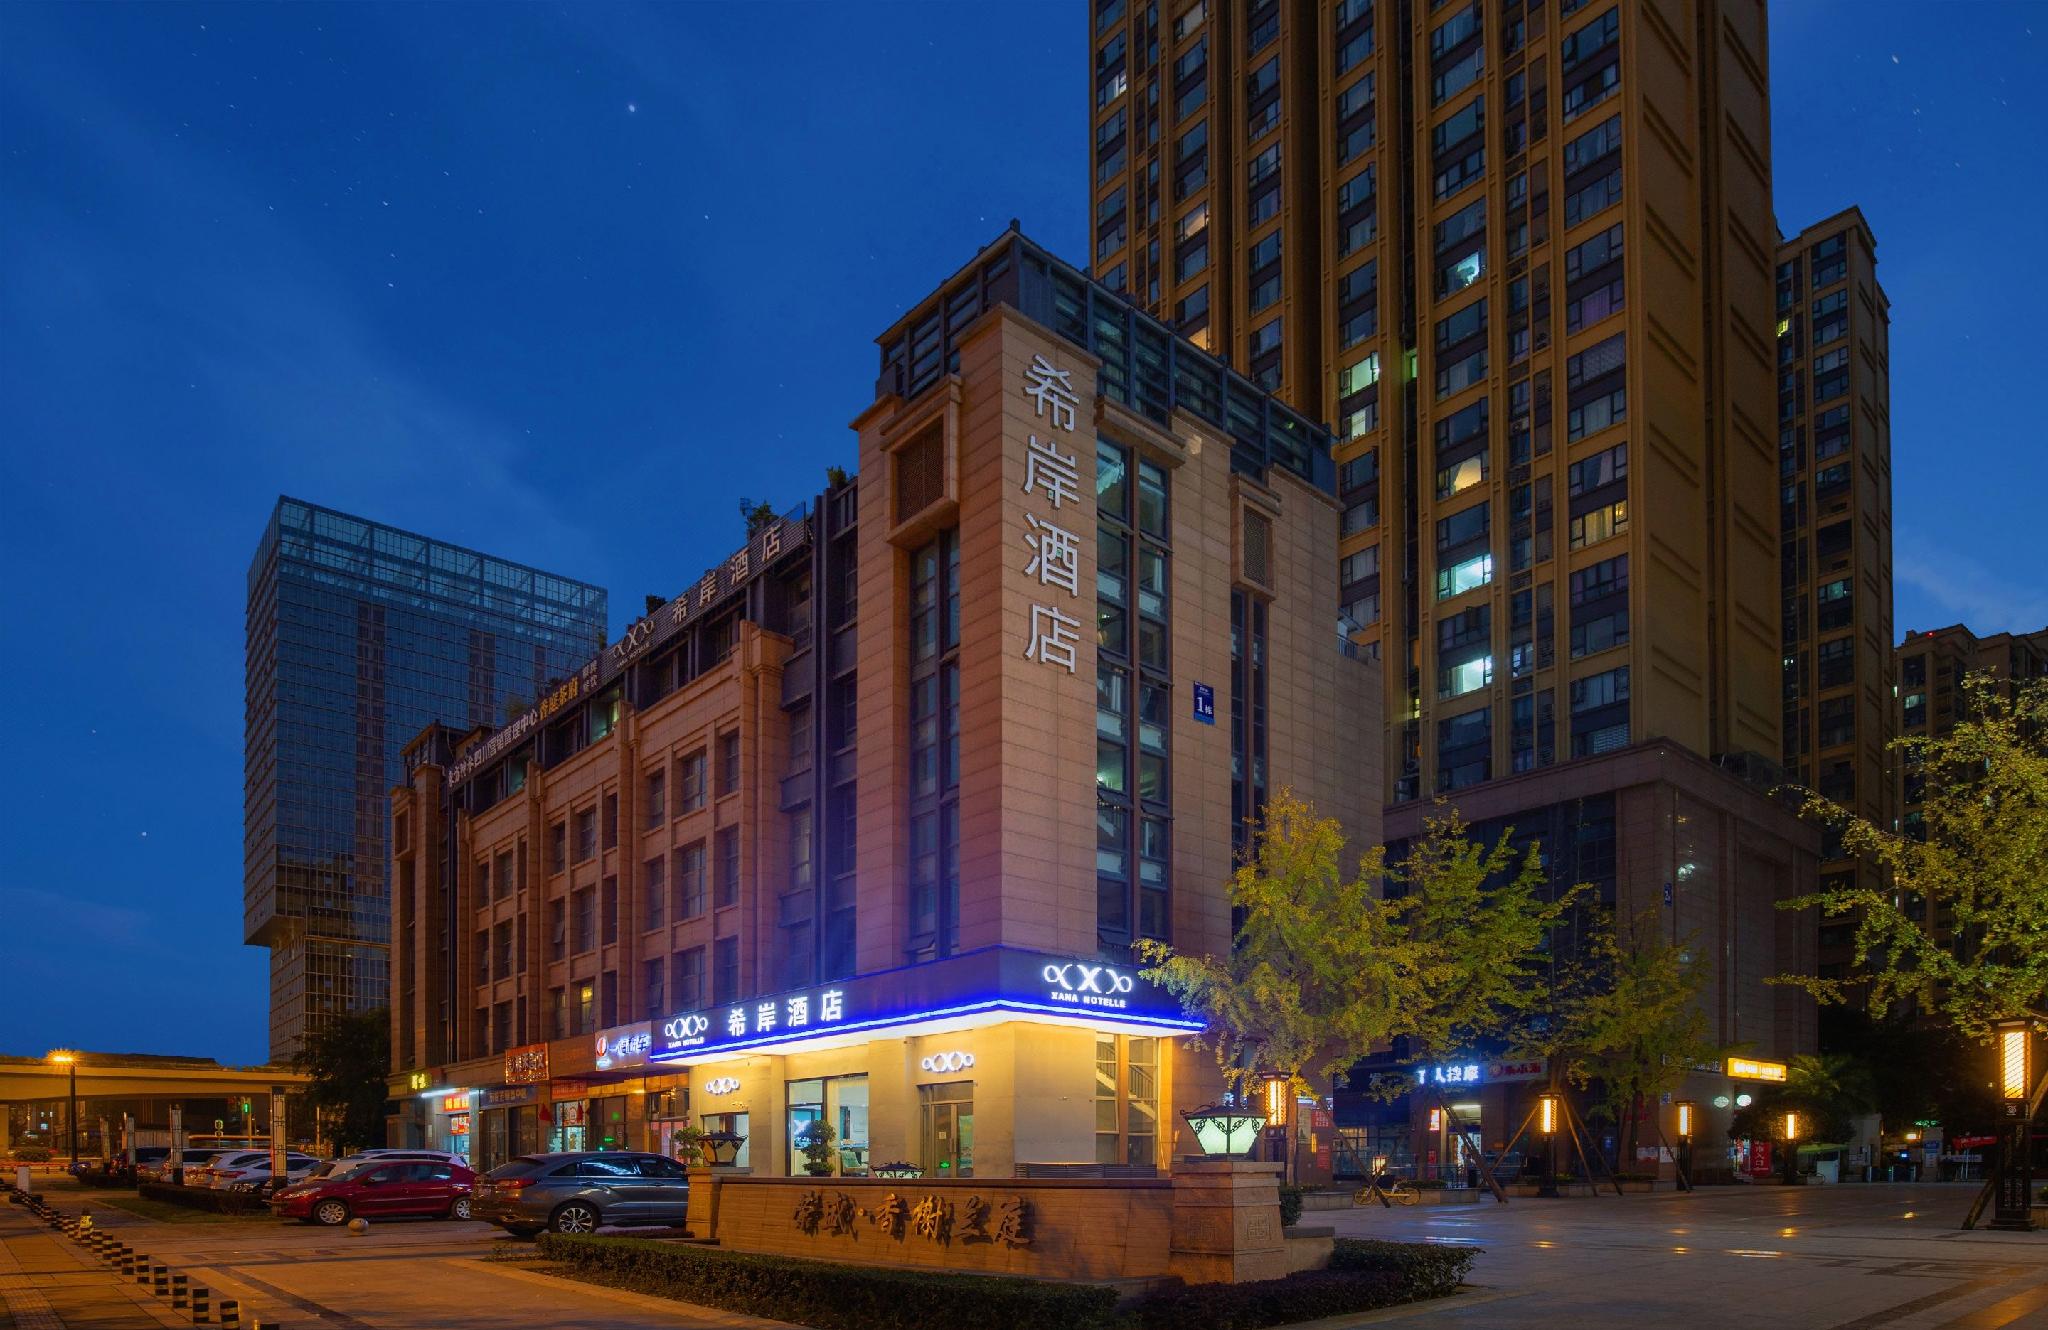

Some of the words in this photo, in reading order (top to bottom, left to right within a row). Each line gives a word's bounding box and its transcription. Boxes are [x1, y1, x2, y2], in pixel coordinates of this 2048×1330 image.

[1024, 354, 1080, 674] 希岸酒店
[672, 522, 782, 624] 希岸酒店
[728, 989, 844, 1037] 希岸酒店
[1051, 991, 1078, 1003] XANA
[1083, 995, 1127, 1008] HOTELLE
